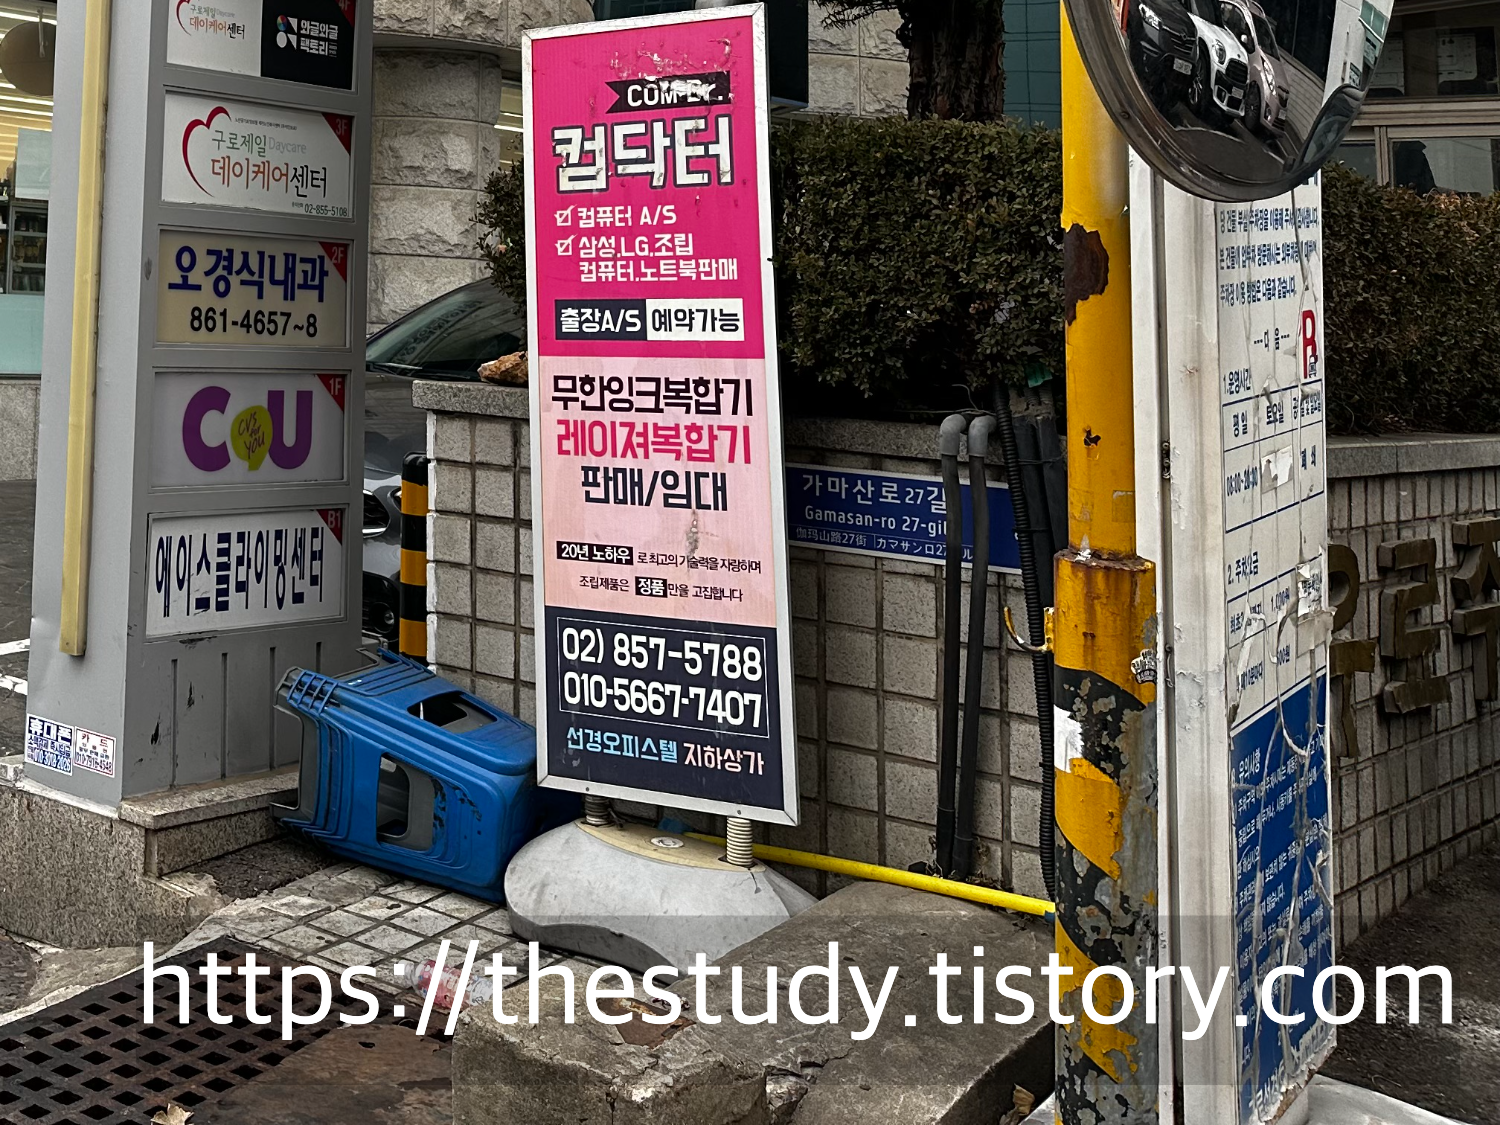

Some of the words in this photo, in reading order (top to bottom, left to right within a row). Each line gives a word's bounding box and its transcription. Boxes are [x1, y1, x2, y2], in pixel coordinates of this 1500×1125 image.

[190, 3, 217, 18] 구로제일
[189, 15, 246, 40] 데이케어센터
[300, 19, 339, 40] 와글와글
[299, 37, 329, 56] 팩토리
[335, 117, 349, 137] 3F
[211, 129, 268, 158] 구로제일
[268, 136, 307, 155] Daycare
[551, 113, 734, 194] 컴닥터
[211, 155, 328, 199] 데이케어센터
[304, 202, 348, 218] 02-855-5108
[577, 204, 633, 228] 컴퓨터
[639, 203, 677, 226] A/S
[1227, 209, 1237, 233] 건물
[1249, 208, 1269, 232] 주차장을
[331, 246, 345, 264] 2F
[578, 233, 694, 259] 삼성.LG.조립
[167, 245, 329, 303] 오경식내과
[579, 258, 739, 283] 컴퓨터.노트북판매
[1219, 282, 1235, 307] 주차장
[190, 306, 318, 338] 861-4657~8
[560, 306, 642, 335] 출장A/S
[651, 307, 741, 334] 예약가능
[329, 377, 342, 396] 1F
[551, 374, 753, 417] 무한잉크복합기
[182, 385, 313, 472] CU
[556, 419, 752, 464] 레이져복합기
[580, 465, 728, 512] 판매/임대
[327, 510, 341, 528] B1
[804, 505, 897, 530] Gamasan-ro
[902, 516, 947, 537] 27-gil
[155, 526, 324, 618] 에이스클라이밍센터
[561, 543, 589, 561] 20년
[591, 546, 631, 563] 노하우
[648, 553, 678, 567] 최고의
[679, 555, 720, 571] 기술력을
[720, 559, 762, 574] 자랑하며
[579, 575, 630, 592] 조립제품은
[637, 577, 666, 597] 정품
[667, 582, 689, 598] 만을
[691, 584, 744, 602] 고집합니다
[562, 626, 604, 664] 02)
[613, 632, 762, 682] 857-5788
[563, 671, 762, 728] 010-5667-7407
[29, 718, 72, 746] 휴대폰
[566, 726, 678, 763] 선경오피스텔
[683, 742, 765, 775] 지하상가
